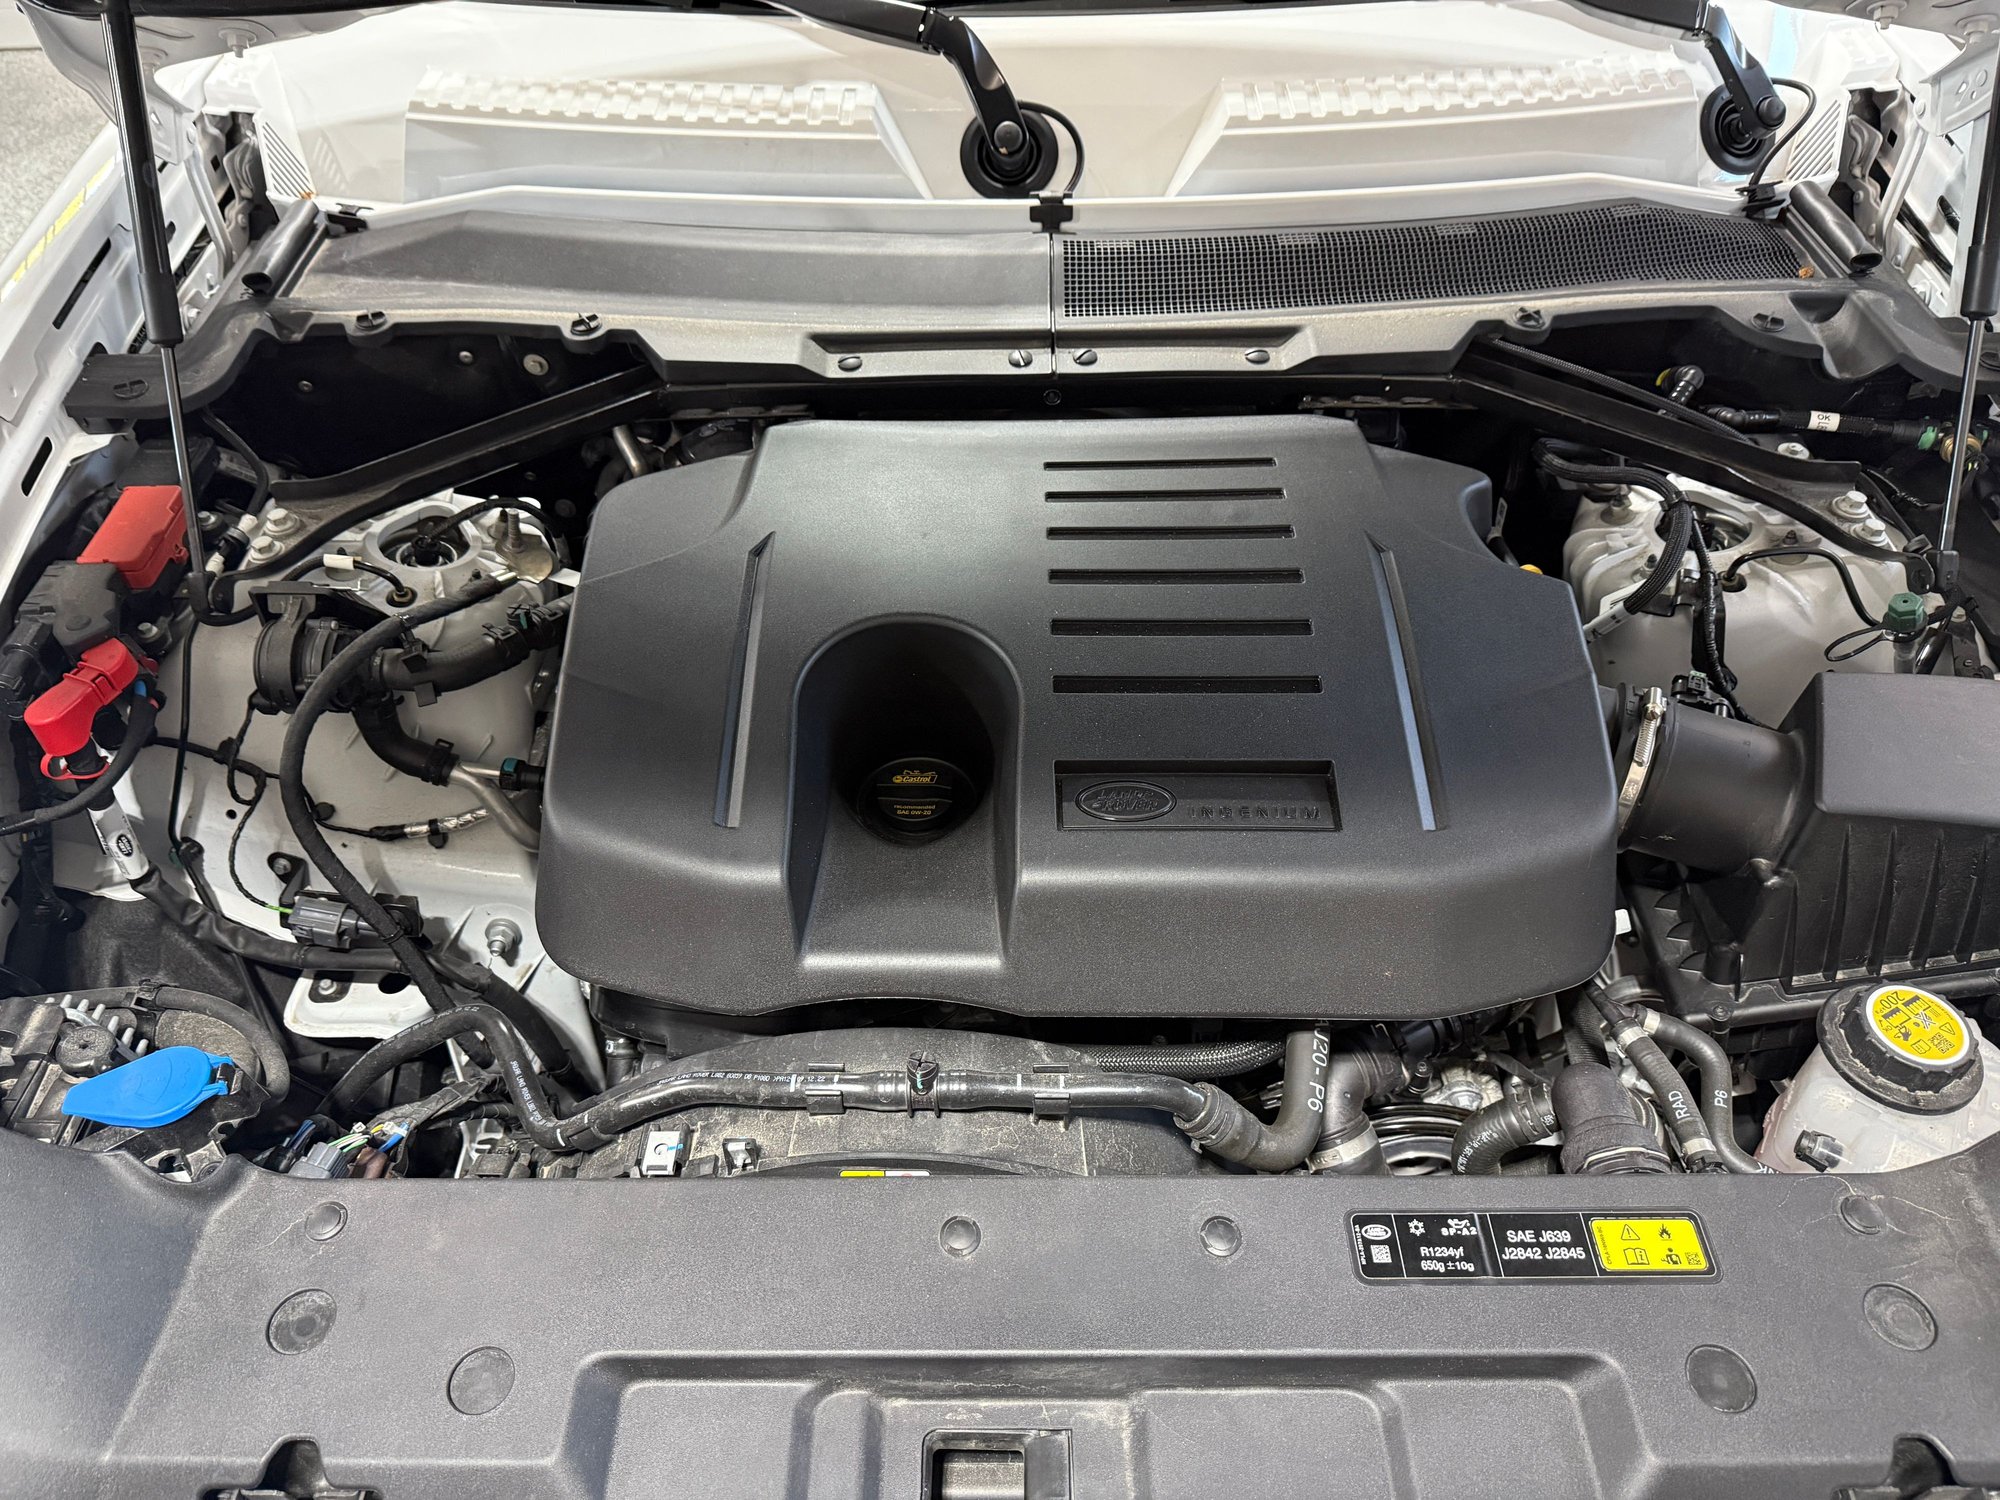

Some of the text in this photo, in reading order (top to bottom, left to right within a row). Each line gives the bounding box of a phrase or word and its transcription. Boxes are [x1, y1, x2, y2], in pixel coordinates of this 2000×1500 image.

[1817, 413, 1831, 421] OK
[902, 775, 931, 783] Castrol
[1187, 805, 1321, 820] INGENIUM
[1879, 991, 1905, 1010] 200
[1668, 1090, 1690, 1120] RAD
[1714, 1089, 1728, 1108] P6
[1440, 1226, 1478, 1236] SP-A2
[1506, 1229, 1572, 1243] SAE J639
[1420, 1246, 1464, 1259] R1234yf
[1501, 1246, 1586, 1260] J2842 J2845
[1420, 1260, 1475, 1273] 650g ±10g
